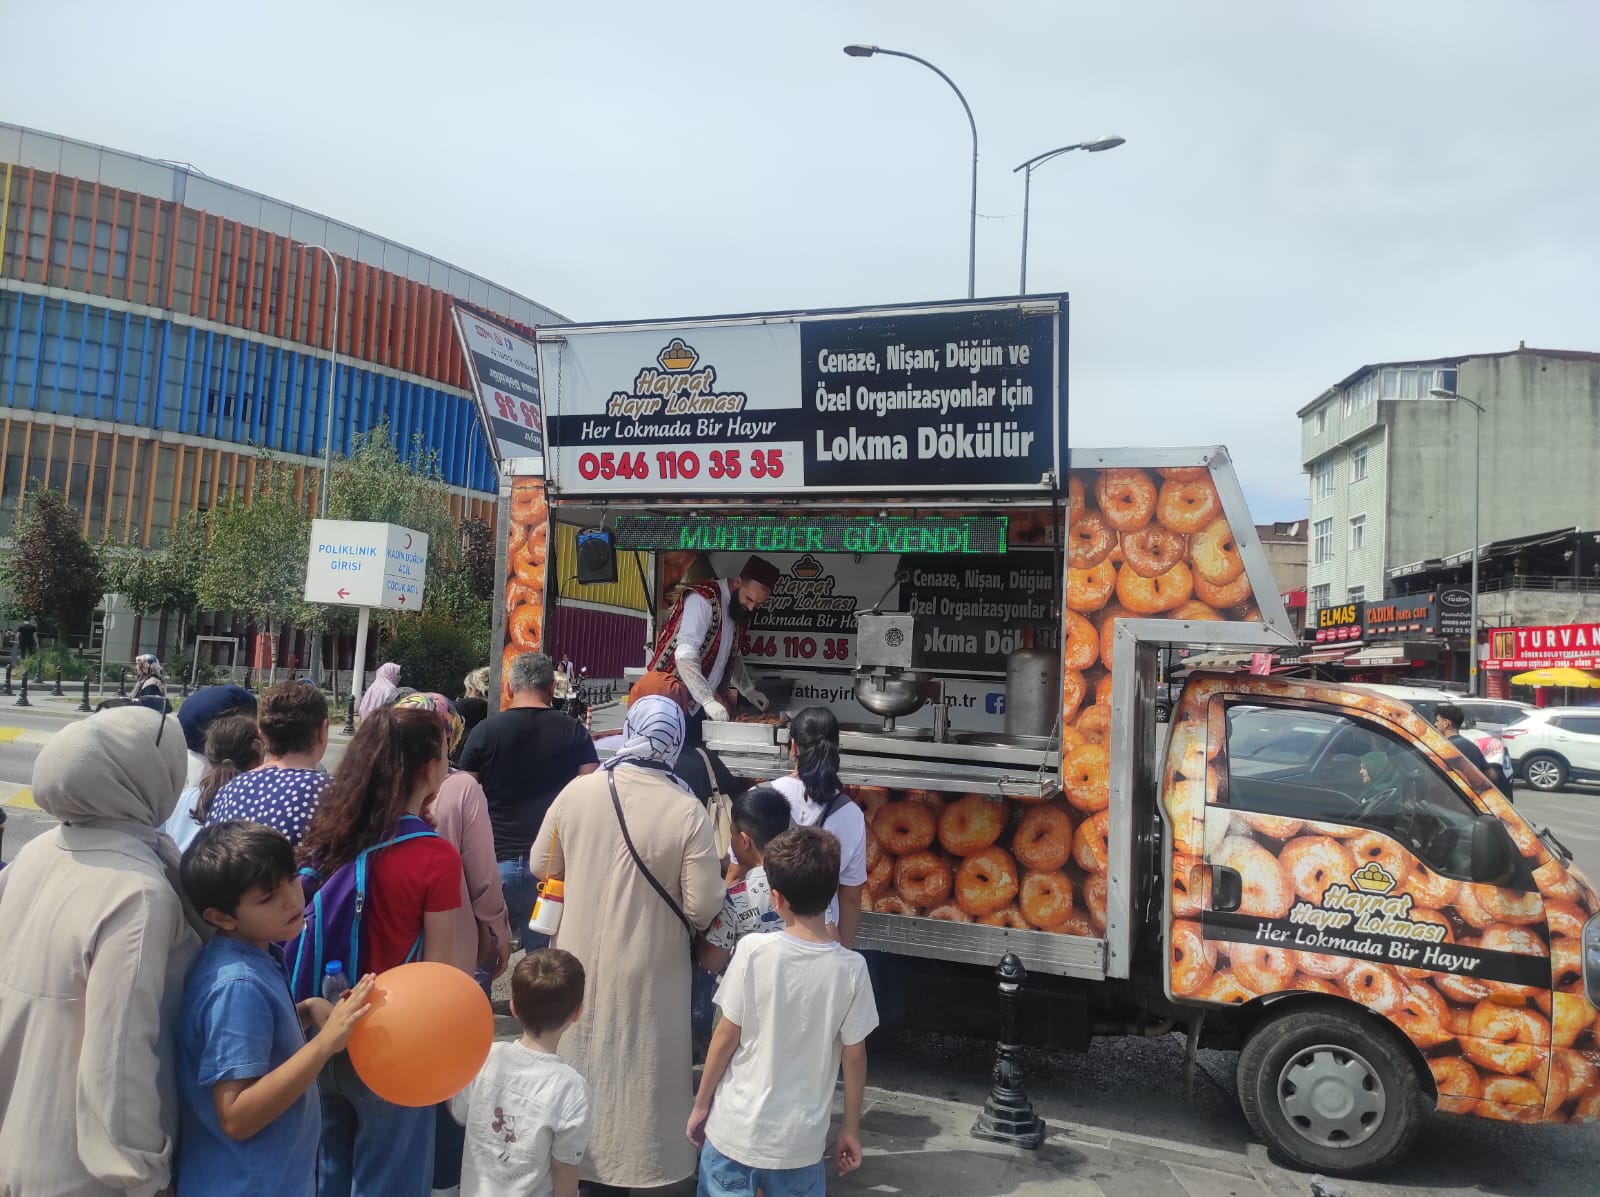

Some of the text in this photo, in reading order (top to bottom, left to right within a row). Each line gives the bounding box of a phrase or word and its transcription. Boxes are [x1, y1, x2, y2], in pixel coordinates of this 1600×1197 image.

[818, 338, 1030, 375] Cenaze, Nişan, Düğün ve
[637, 370, 713, 397] Hayrat
[608, 394, 744, 420] Hayır Lokması
[815, 378, 1033, 417] Özel Organizasyonlar için
[580, 416, 777, 440] Her Lokmada Bir Hayır
[816, 421, 1035, 462] Lokma Dökülür
[578, 449, 784, 481] 0546 110 35 35
[319, 543, 377, 556] POLİKLİNİK
[773, 576, 833, 597] Hayrat
[913, 569, 1052, 594] Cenaze, Nişan, Düğün
[757, 596, 792, 612] ayır
[909, 592, 936, 615] Özel
[941, 598, 1046, 622] Organizasyonlar
[1320, 605, 1356, 627] ELMAS
[754, 613, 813, 627] Lokmada
[816, 614, 838, 628] Bir
[740, 636, 849, 660] 546 110 35
[1324, 885, 1412, 918] Hayrat
[1290, 903, 1447, 942] Hayır Lokması
[1255, 922, 1481, 970] Her Lokmada Bir Hayır
